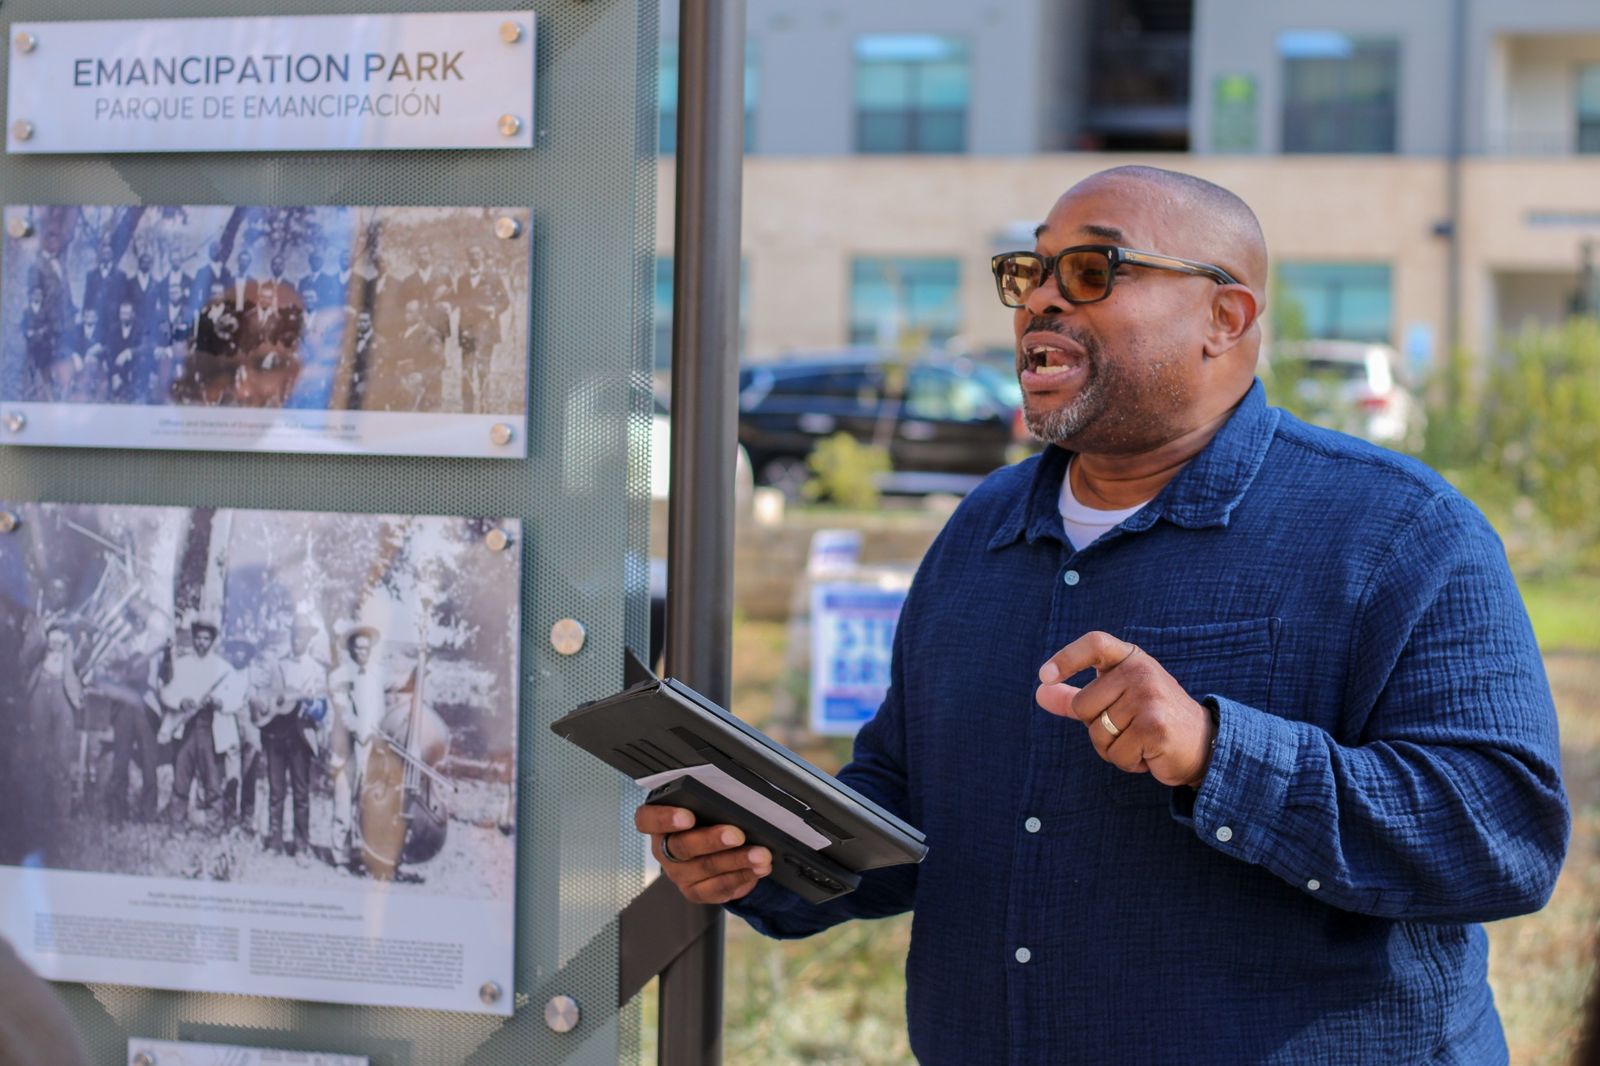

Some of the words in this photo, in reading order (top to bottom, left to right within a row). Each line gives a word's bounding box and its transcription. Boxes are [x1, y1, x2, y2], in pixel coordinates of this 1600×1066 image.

[74, 53, 349, 87] EMANCIPATION
[364, 51, 465, 82] PARK
[95, 95, 195, 120] PARQUE
[202, 96, 236, 118] DE
[243, 88, 441, 118] EMANCIPACIÓN
